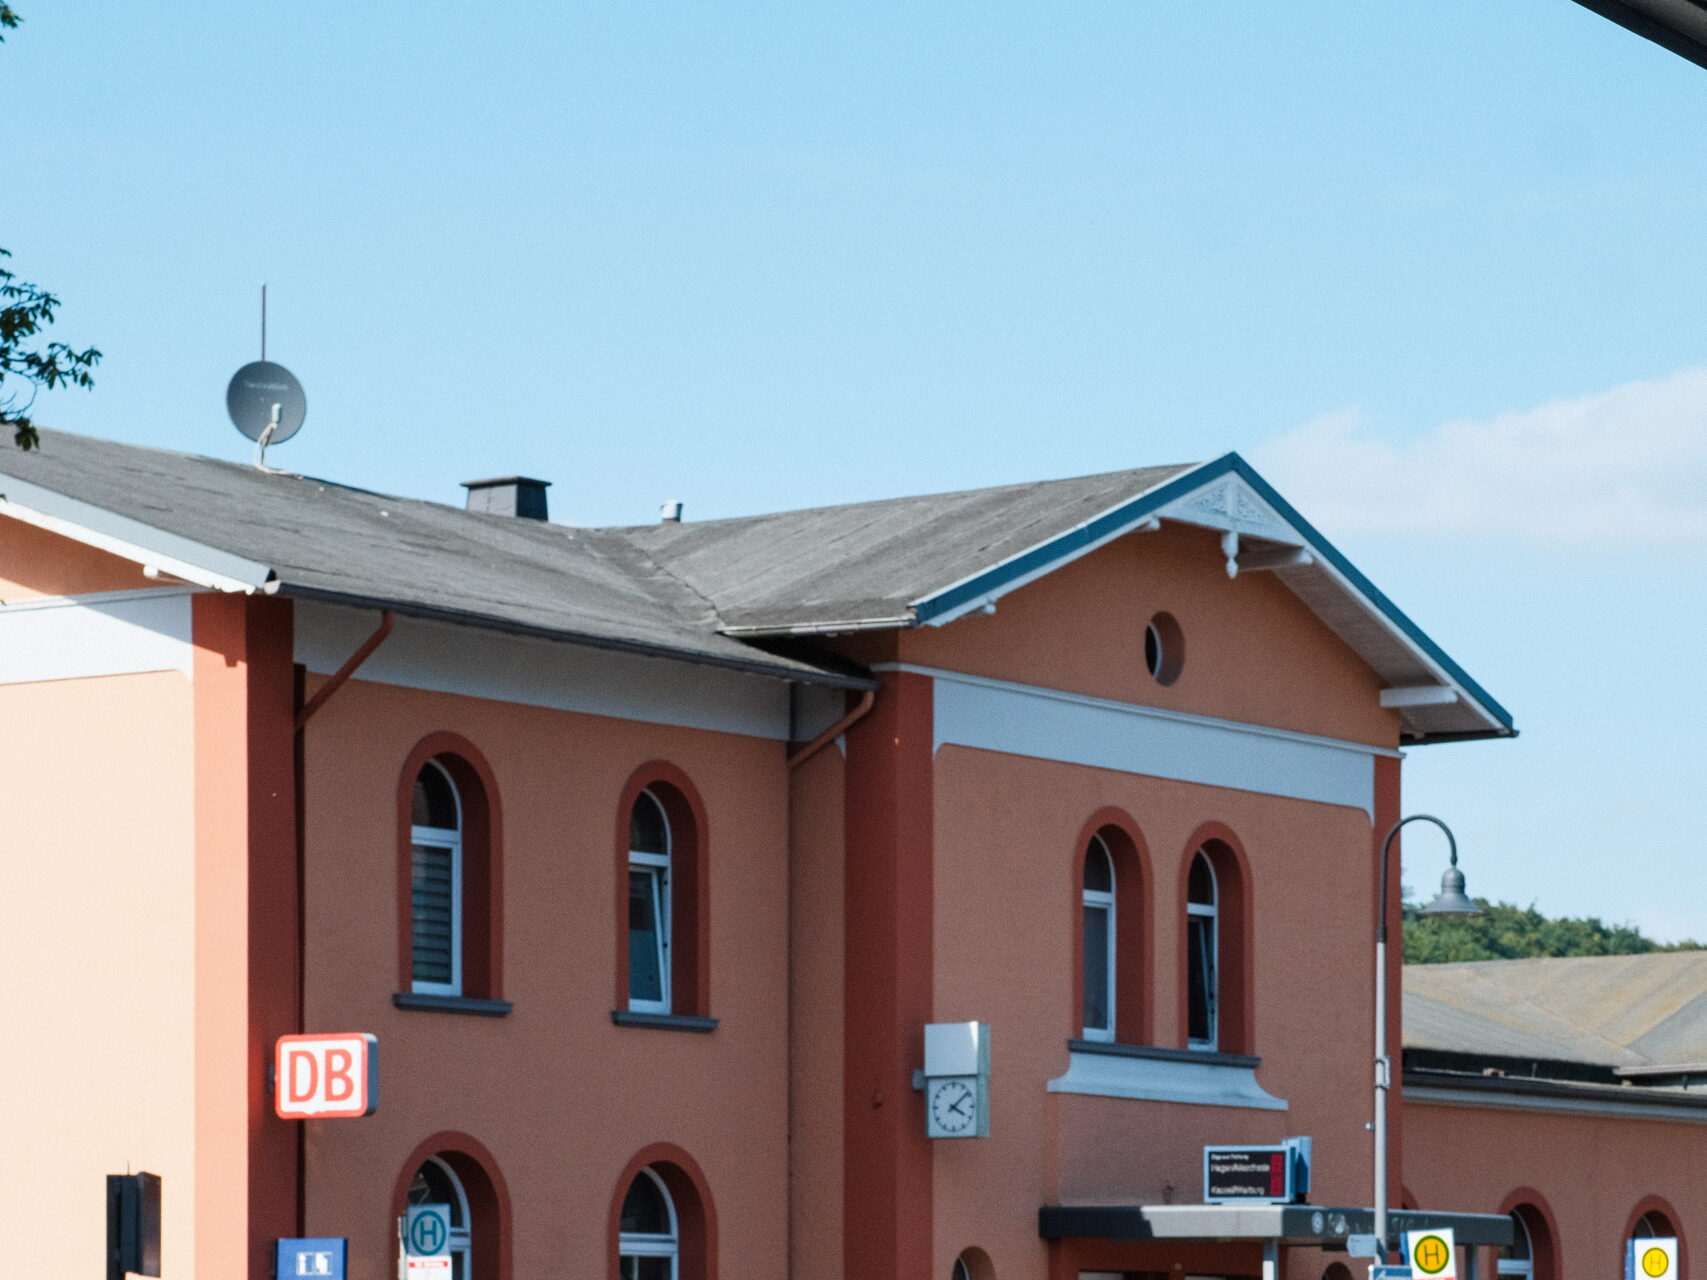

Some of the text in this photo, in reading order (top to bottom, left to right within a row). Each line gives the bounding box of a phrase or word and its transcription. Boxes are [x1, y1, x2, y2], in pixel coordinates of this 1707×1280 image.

[289, 1048, 355, 1103] DB
[420, 1220, 437, 1247] H
[1424, 1244, 1440, 1266] H
